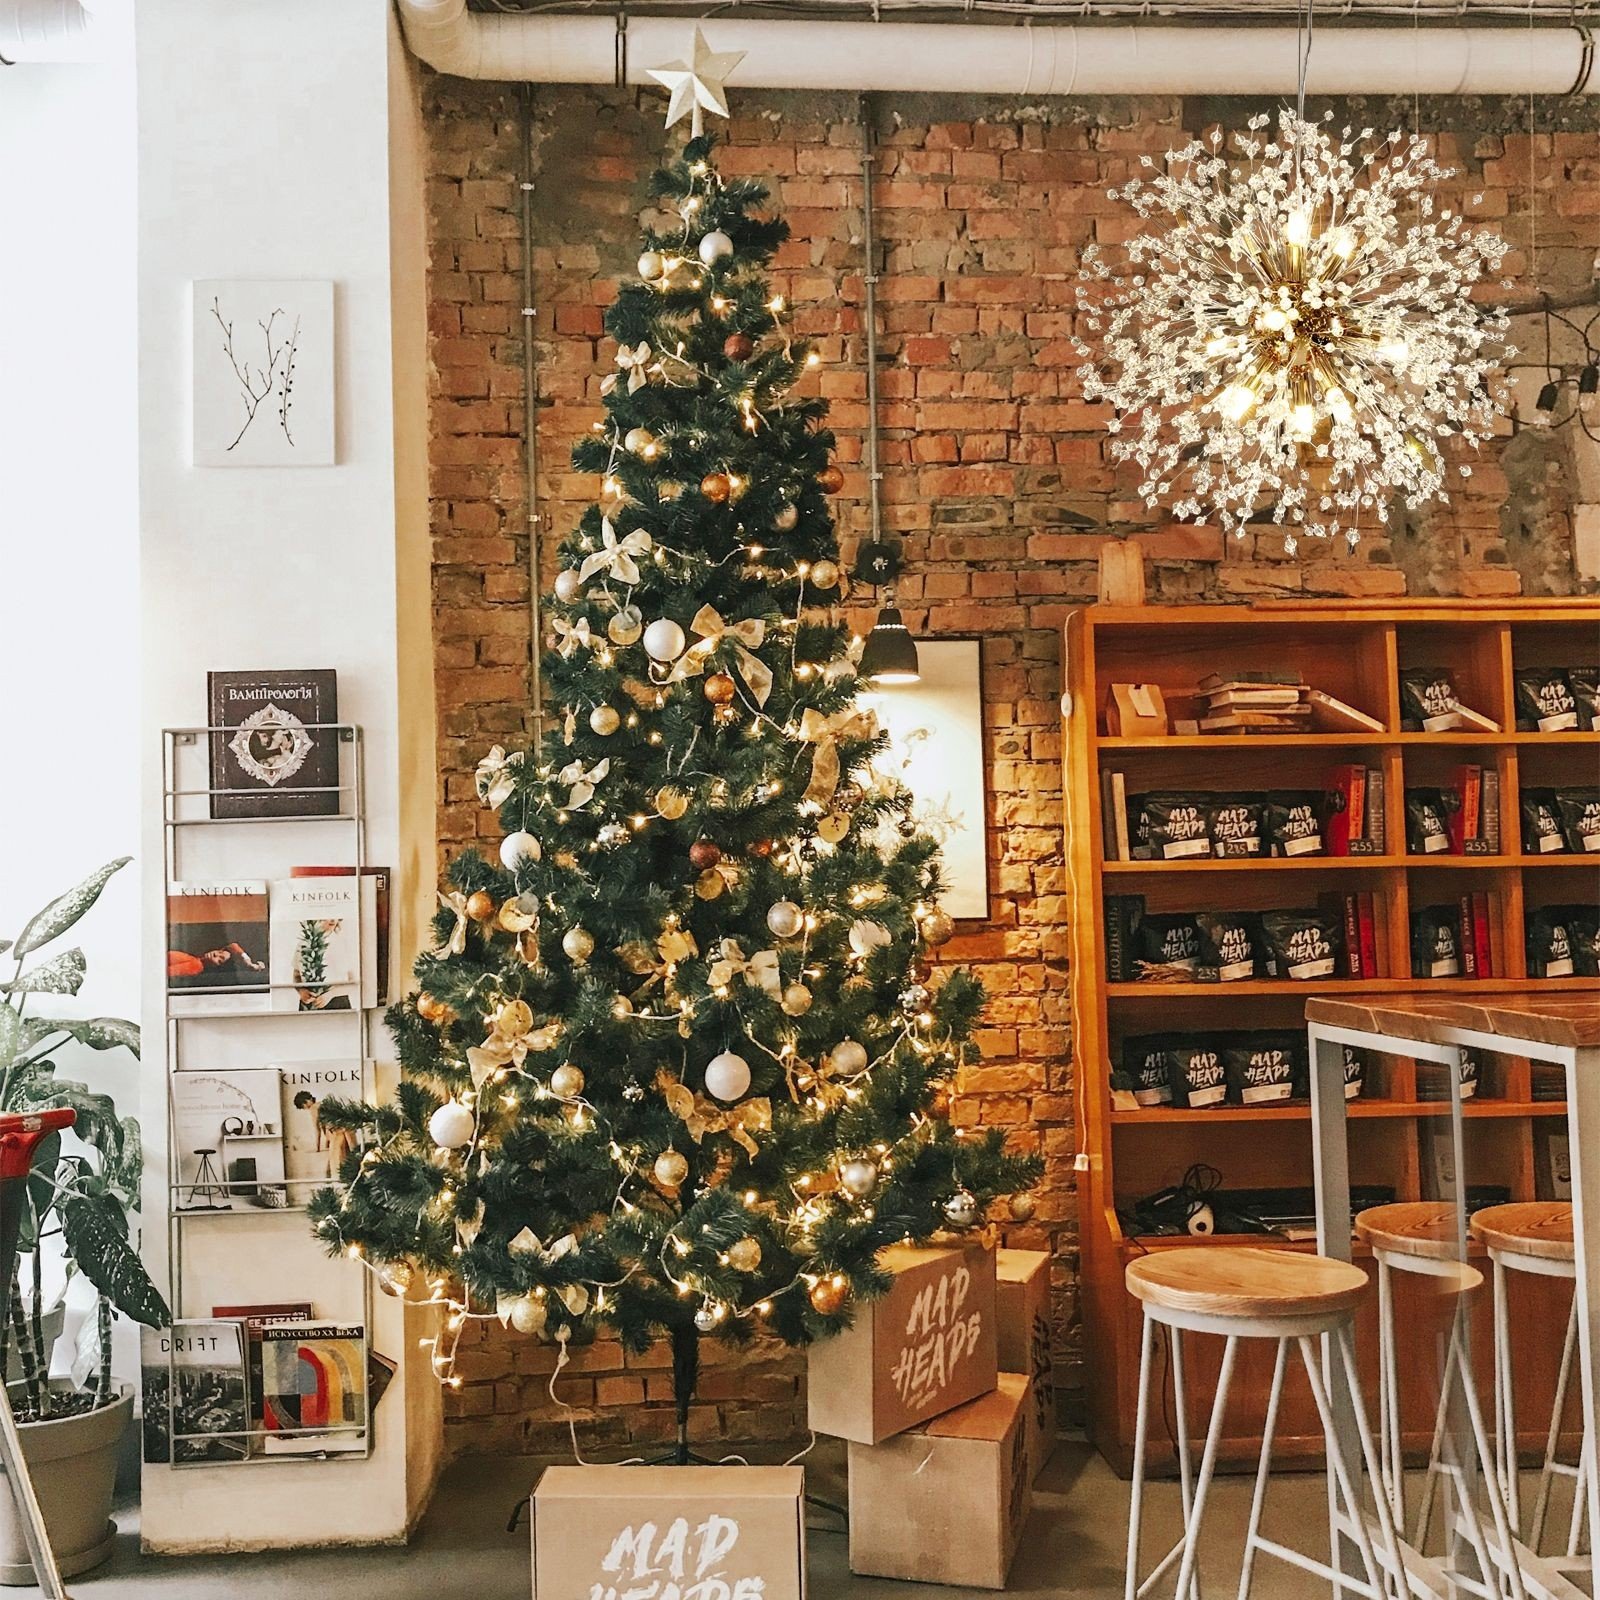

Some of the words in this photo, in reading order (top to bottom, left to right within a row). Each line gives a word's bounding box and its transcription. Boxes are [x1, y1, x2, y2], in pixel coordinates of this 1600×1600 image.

[1169, 807, 1197, 822] MAD
[1218, 808, 1248, 823] MAD
[1164, 820, 1206, 839] HEADS
[1214, 820, 1257, 839] HEADS
[1350, 841, 1372, 852] 255
[1465, 842, 1487, 852] 255
[181, 886, 253, 897] KINFOLK
[292, 891, 352, 902] KINFOLK
[1166, 926, 1193, 941] MAD
[1222, 928, 1246, 945] MAD
[1290, 927, 1321, 945] MAD
[1286, 941, 1330, 960] HEADS
[1189, 1052, 1217, 1068] MAD
[1250, 1050, 1283, 1066] MAD
[1185, 1066, 1224, 1086] HEADS
[1244, 1064, 1290, 1085] HEADS
[906, 1266, 970, 1336] MAD
[268, 1330, 320, 1338] ИСКУССТВО
[336, 1328, 359, 1336] ВЕКА
[890, 1311, 981, 1402] HEADS
[602, 1514, 740, 1583] MAD
